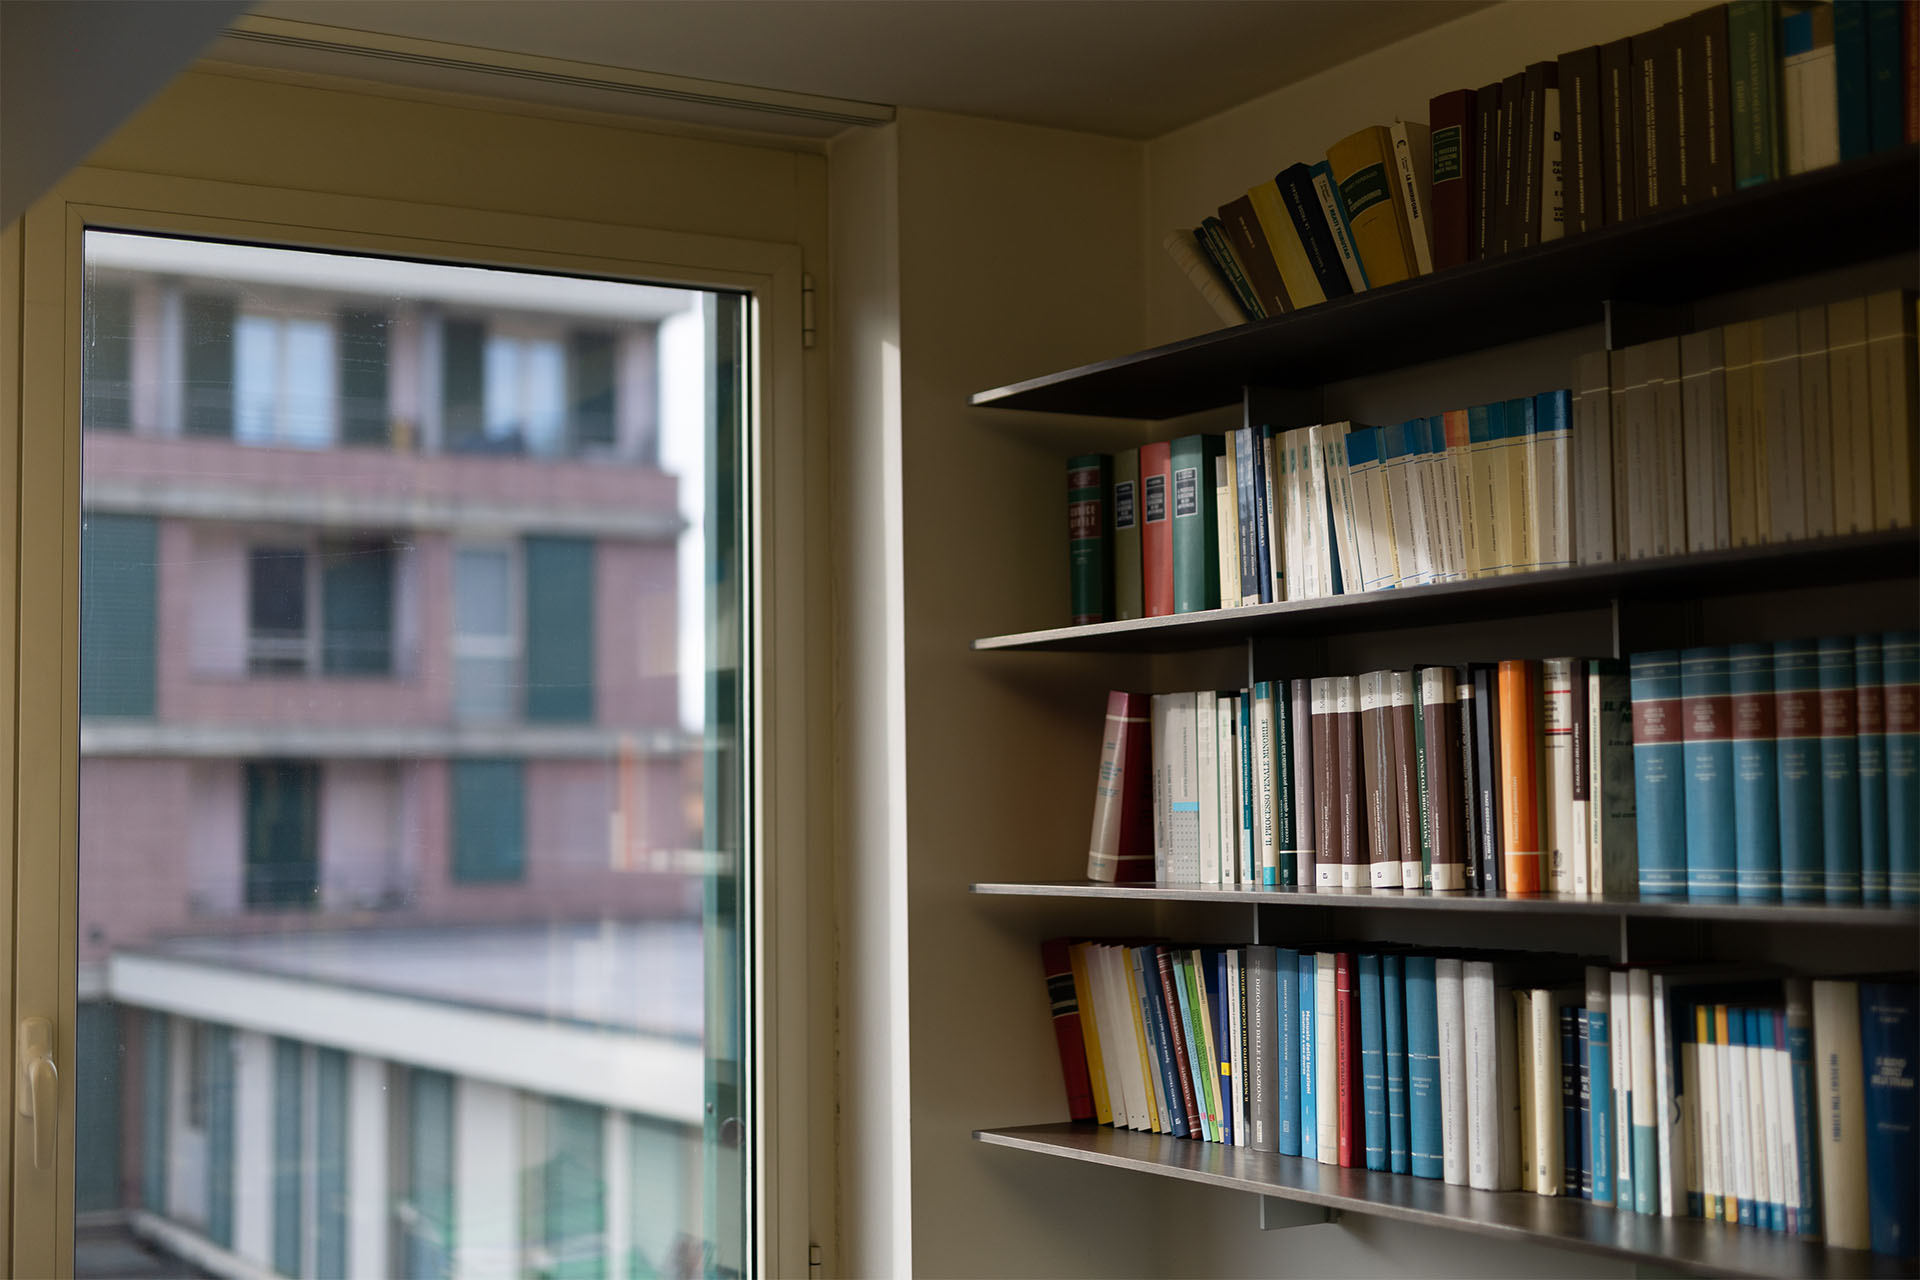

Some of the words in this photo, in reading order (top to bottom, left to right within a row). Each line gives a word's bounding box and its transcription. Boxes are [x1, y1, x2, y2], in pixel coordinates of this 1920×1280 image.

[1366, 681, 1374, 704] Maior
[1261, 718, 1269, 759] MINORILE
[1262, 759, 1270, 792] PENALE
[1263, 793, 1271, 837] PROCESSO
[1265, 837, 1272, 847] IL
[1164, 980, 1173, 1004] EDILIZIA
[1169, 1004, 1181, 1045] CONCESSIONE
